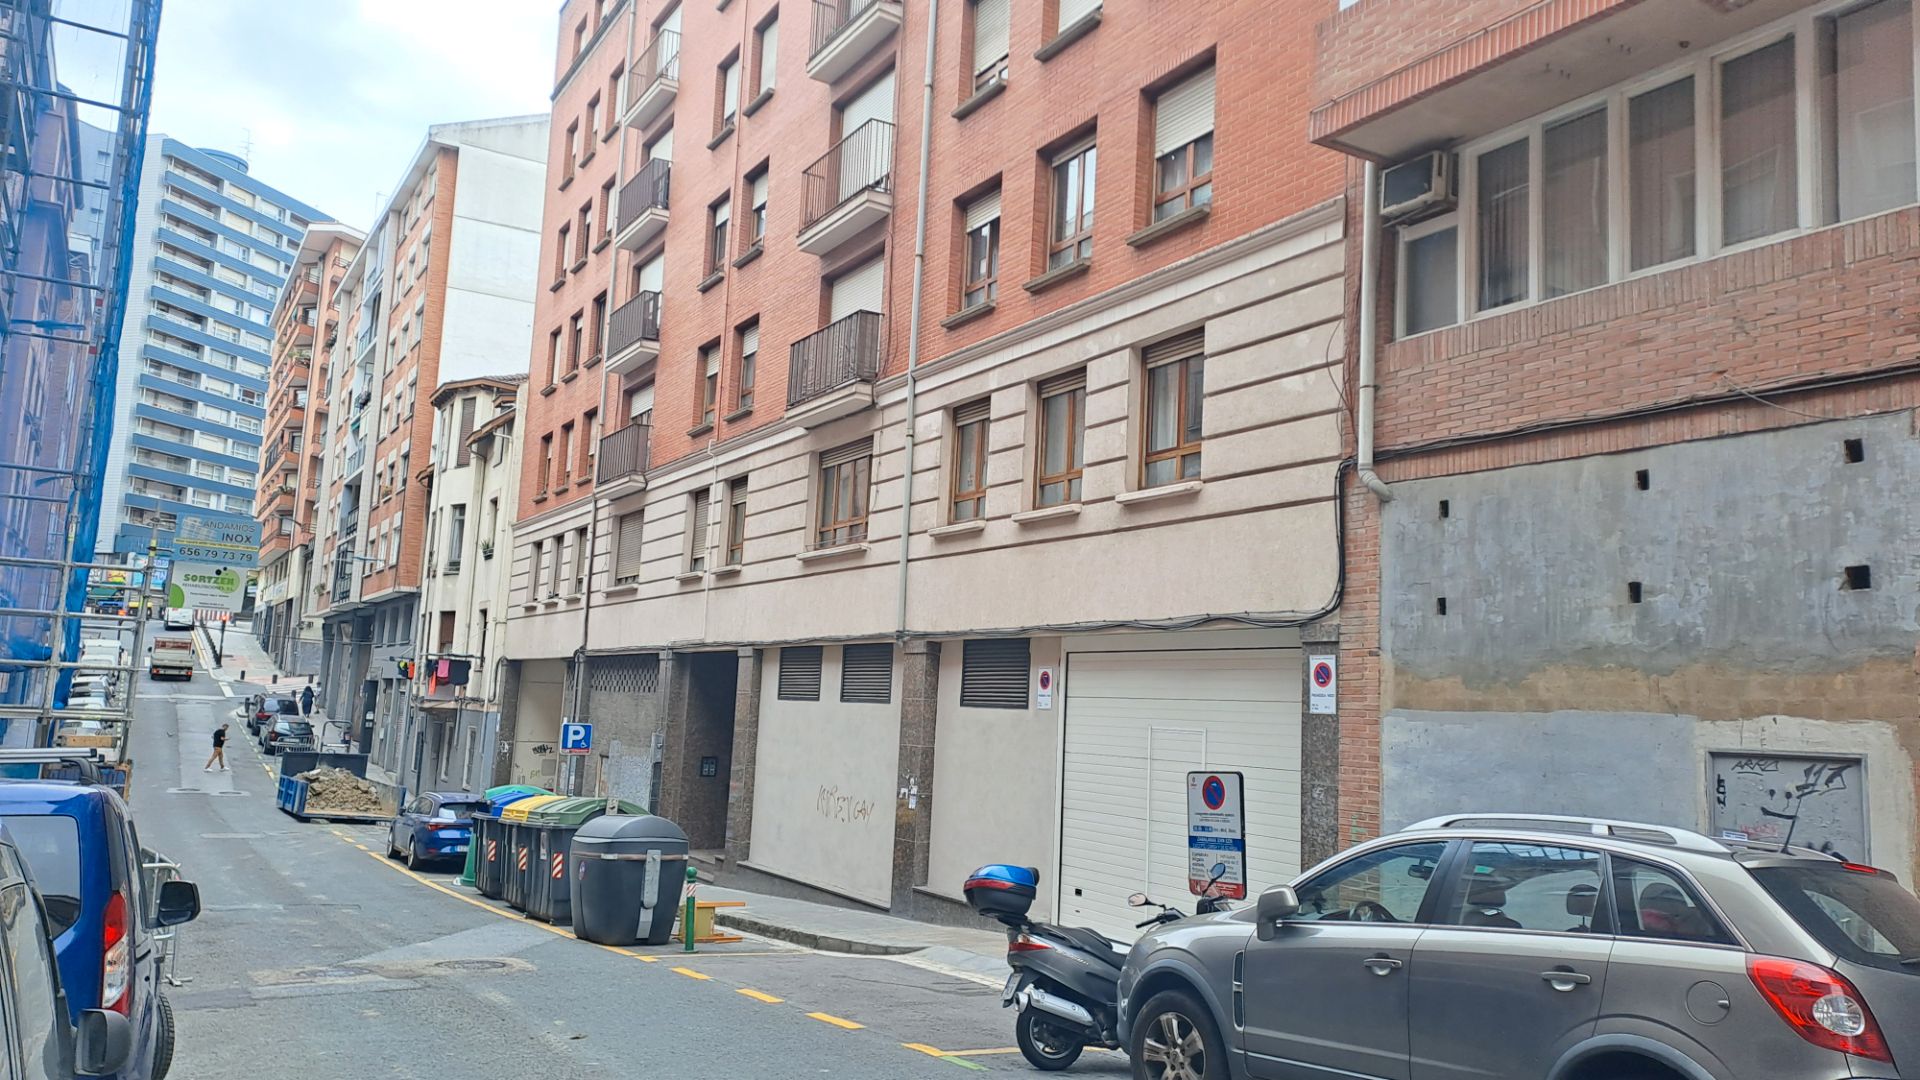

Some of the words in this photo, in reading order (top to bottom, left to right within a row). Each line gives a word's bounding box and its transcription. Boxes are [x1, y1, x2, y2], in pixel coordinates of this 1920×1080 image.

[203, 520, 256, 533] ANDAMIOS
[222, 533, 252, 544] INOX
[179, 546, 201, 557] 656
[204, 549, 218, 559] 79
[222, 551, 235, 560] 73
[239, 553, 253, 562] 79
[567, 725, 585, 749] P
